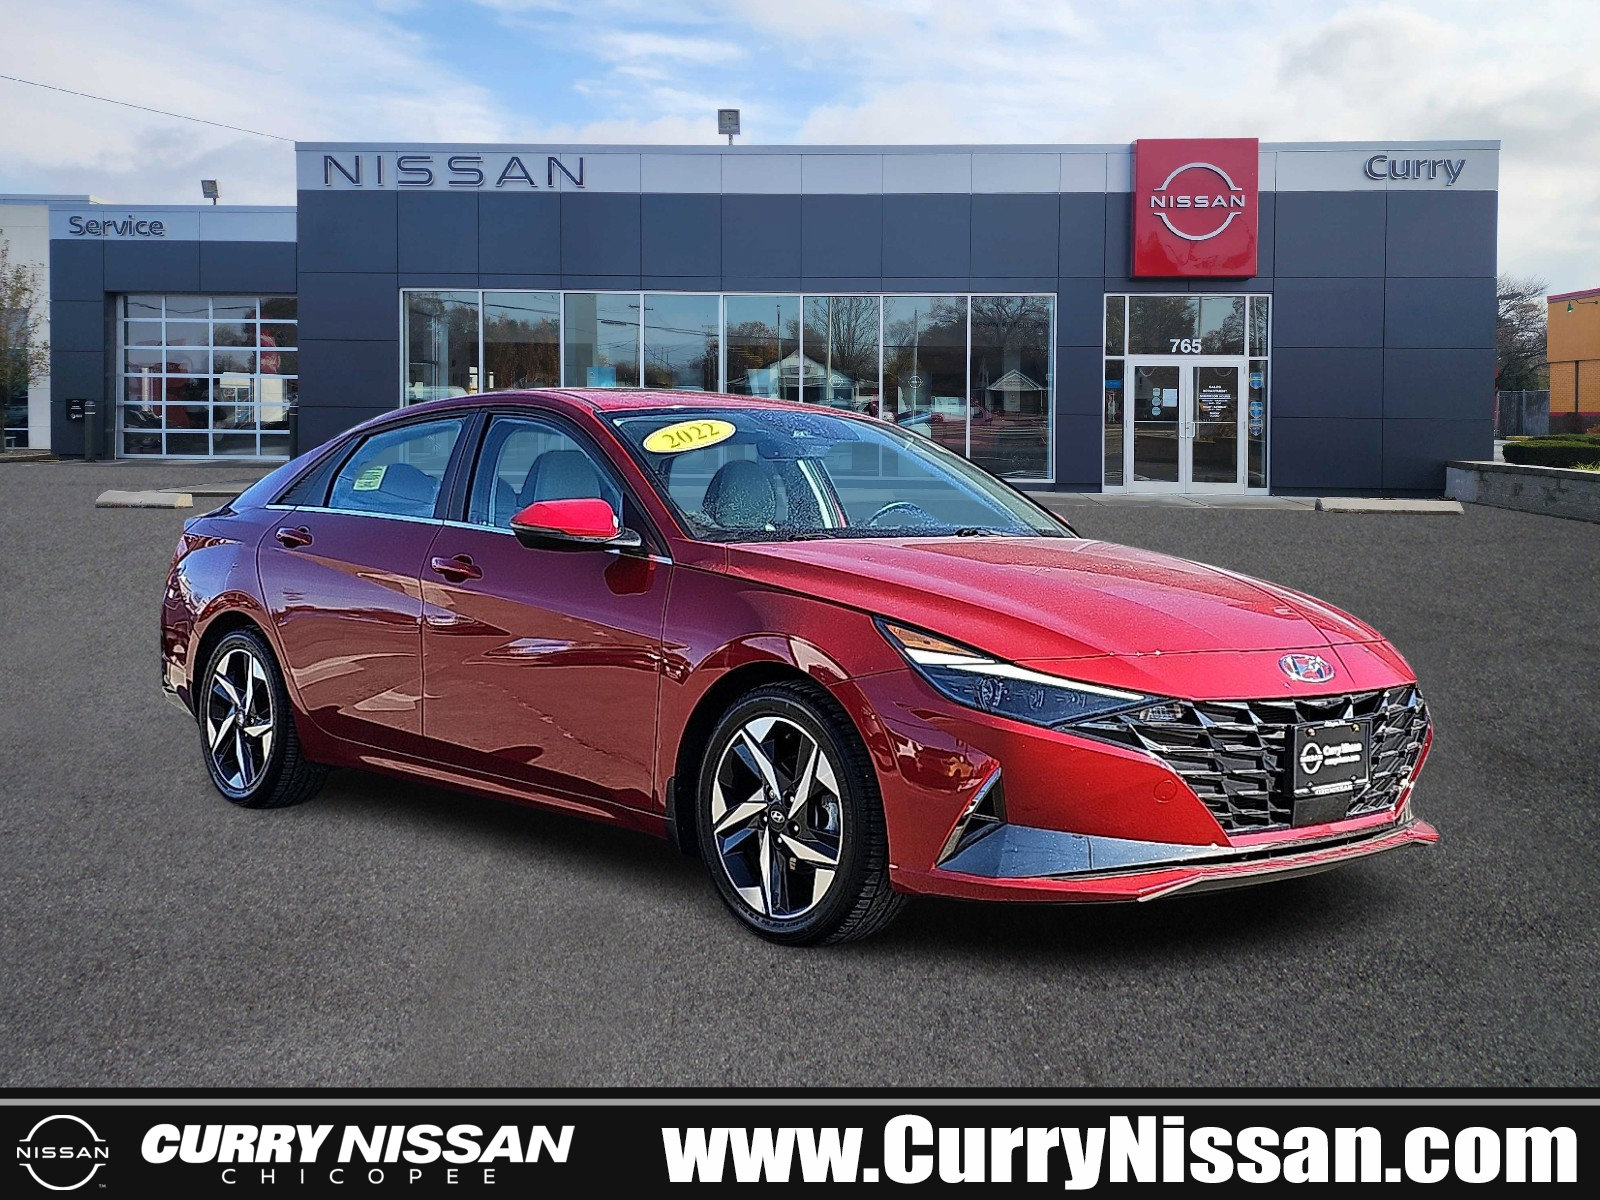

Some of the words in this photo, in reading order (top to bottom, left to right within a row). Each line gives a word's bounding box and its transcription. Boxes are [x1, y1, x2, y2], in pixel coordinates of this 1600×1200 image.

[323, 154, 586, 189] NISSAN
[1364, 154, 1467, 187] Curry
[1150, 194, 1246, 209] NISSAN
[68, 213, 166, 237] Service
[1169, 338, 1203, 354] 765
[662, 422, 719, 448] 2022
